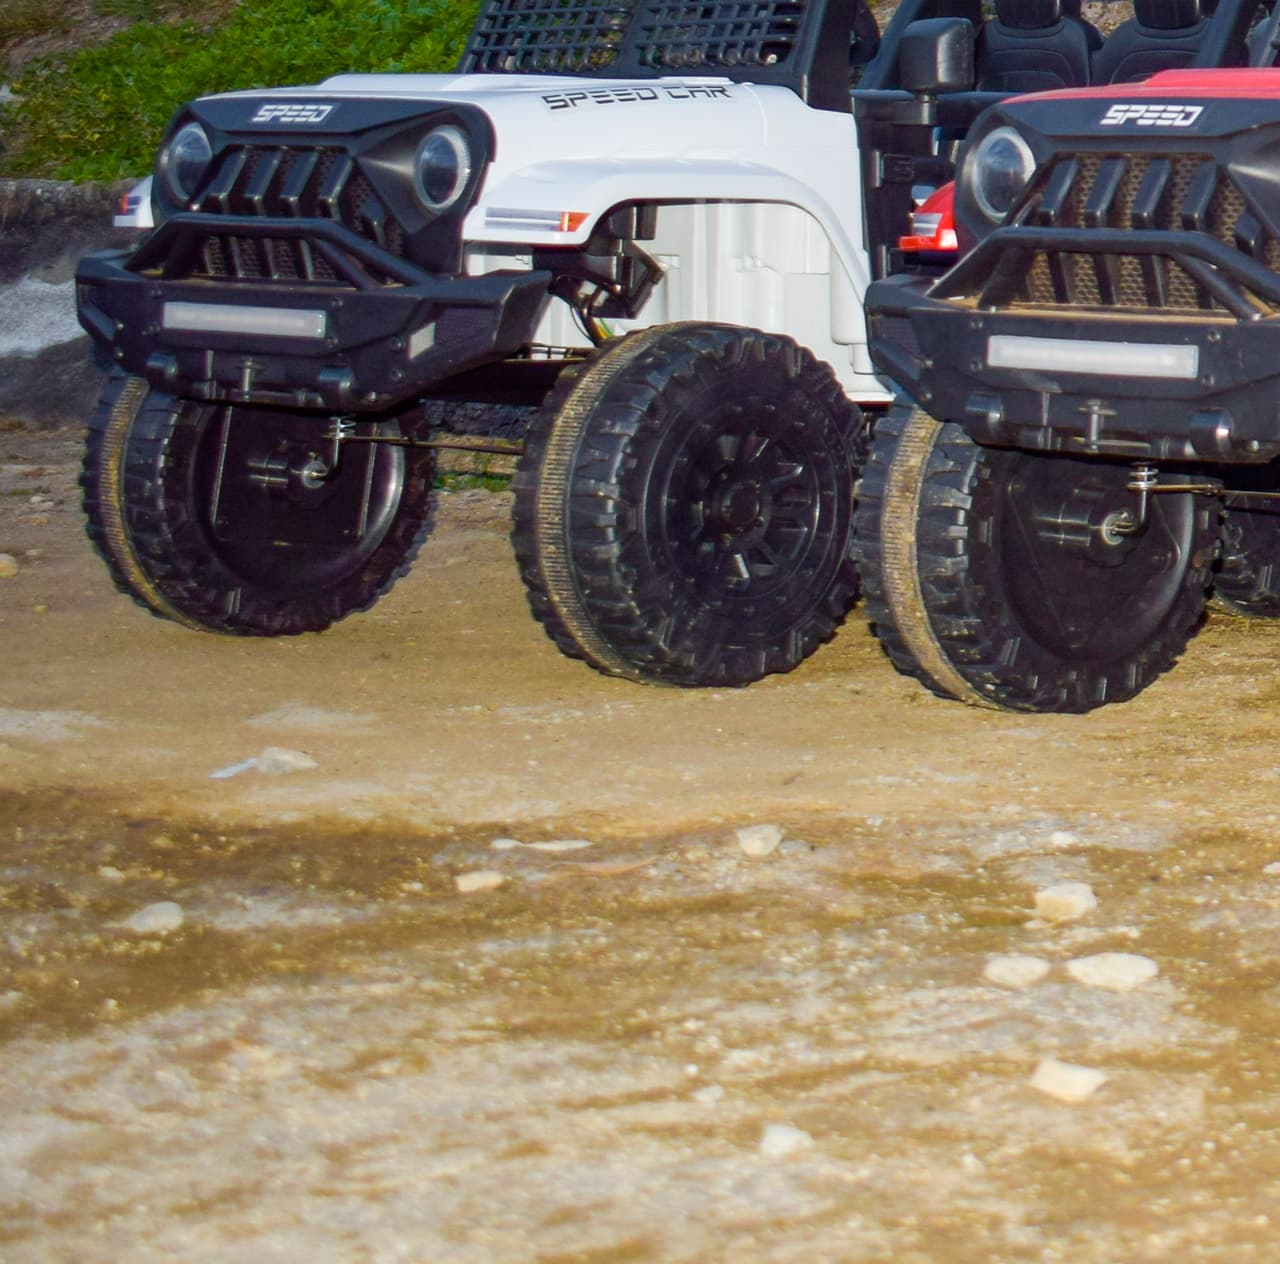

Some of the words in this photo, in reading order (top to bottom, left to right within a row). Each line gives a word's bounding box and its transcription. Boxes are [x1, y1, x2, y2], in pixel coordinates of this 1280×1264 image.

[542, 87, 659, 110] SPEED
[663, 85, 732, 99] CAR
[251, 104, 333, 122] SPEED
[1100, 104, 1204, 127] SPEED
